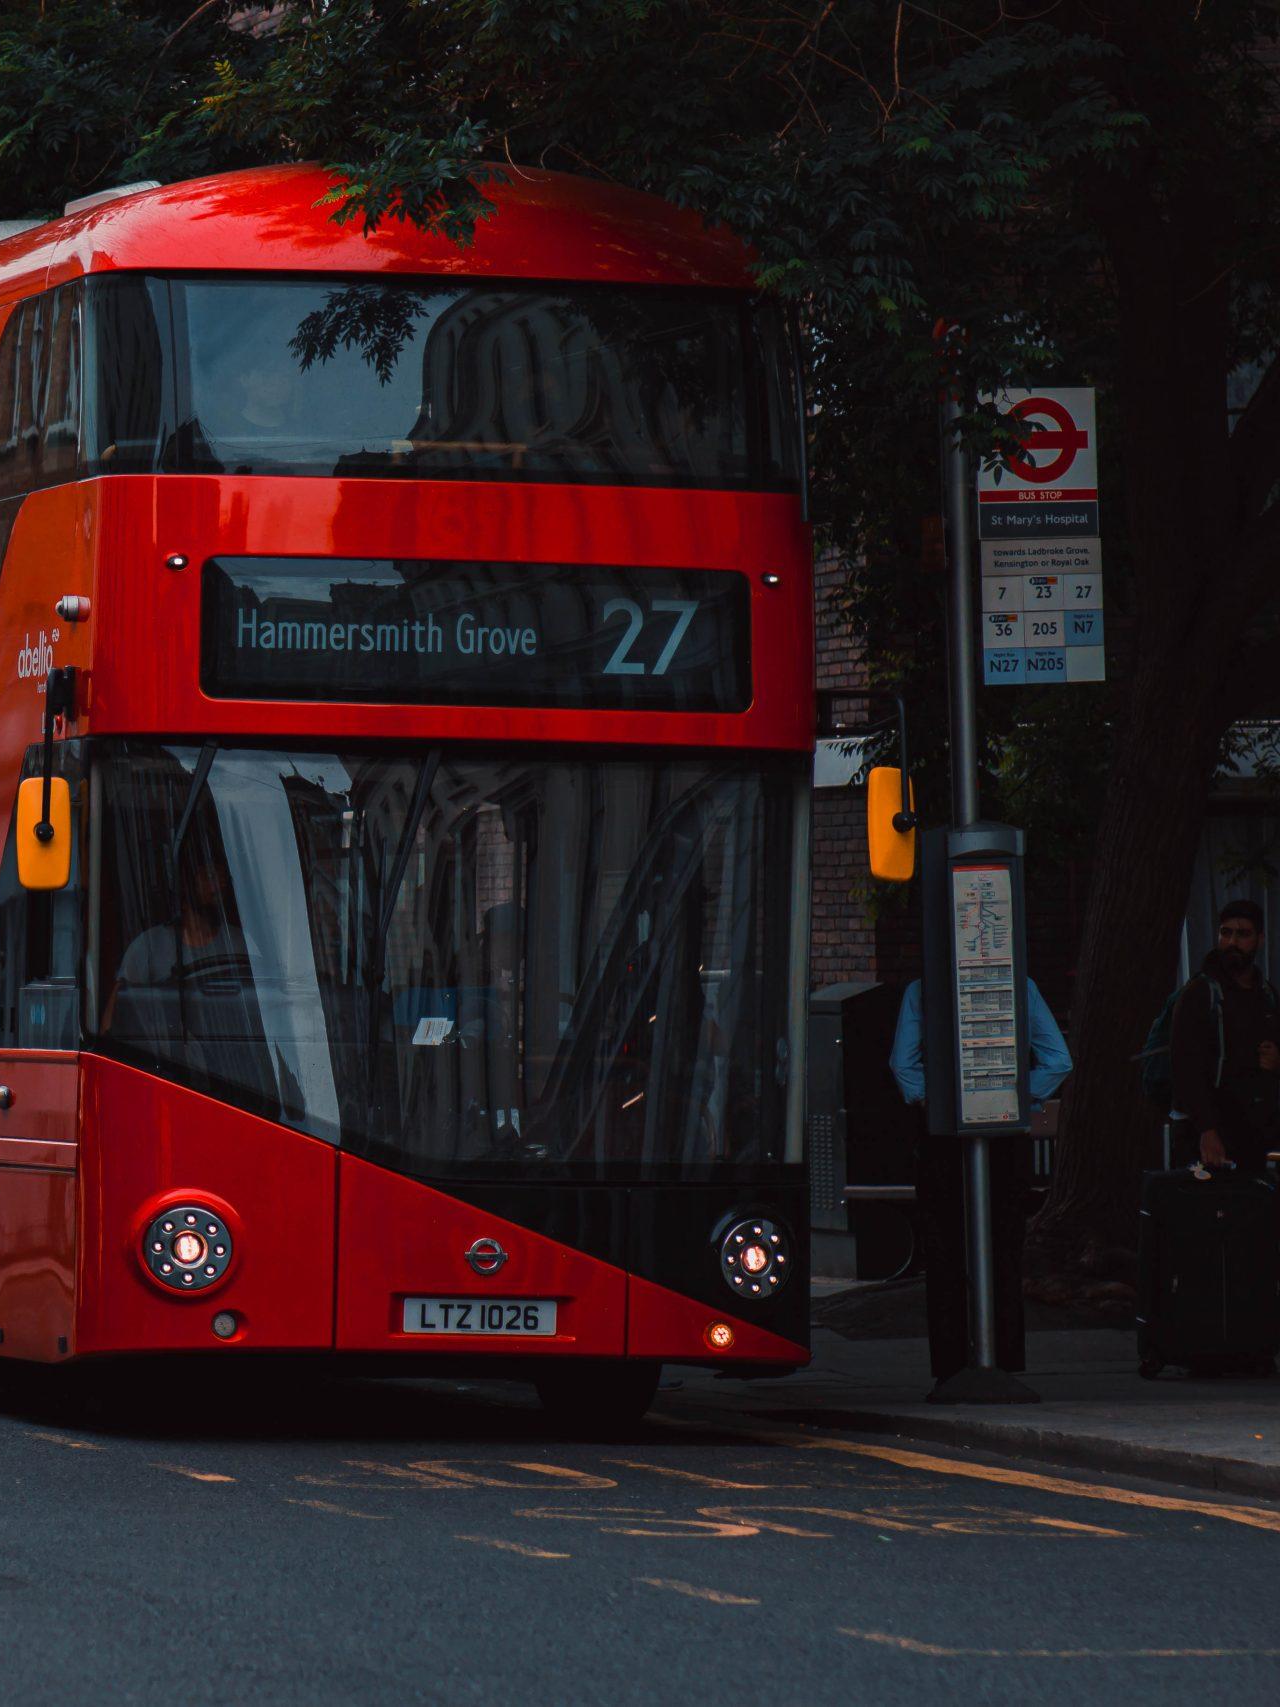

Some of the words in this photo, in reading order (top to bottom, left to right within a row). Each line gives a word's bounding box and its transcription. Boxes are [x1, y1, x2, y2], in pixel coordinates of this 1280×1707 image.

[1018, 491, 1035, 501] BUS
[1039, 491, 1062, 501] STOP
[991, 515, 1003, 525] St
[1006, 515, 1041, 527] Mary's
[1045, 513, 1089, 525] Hospital
[993, 548, 1026, 556] towards
[1028, 546, 1063, 555] Ladbroke
[993, 560, 1038, 569] Kensington
[1051, 558, 1072, 568] Royal
[1074, 558, 1089, 566] Oak
[998, 587, 1007, 600] 7
[1035, 586, 1052, 599] 23
[1075, 585, 1092, 598] 27
[238, 607, 443, 653] Hammersmith
[456, 613, 537, 656] Grove
[995, 624, 1013, 636] 36
[1032, 622, 1057, 635] 205
[1074, 620, 1093, 634] N7
[602, 597, 700, 676] 27
[18, 630, 53, 679] abellio
[990, 659, 1019, 673] N27
[1027, 658, 1064, 672] N205
[420, 1303, 472, 1329] LTZ
[480, 1304, 539, 1331] 1026
